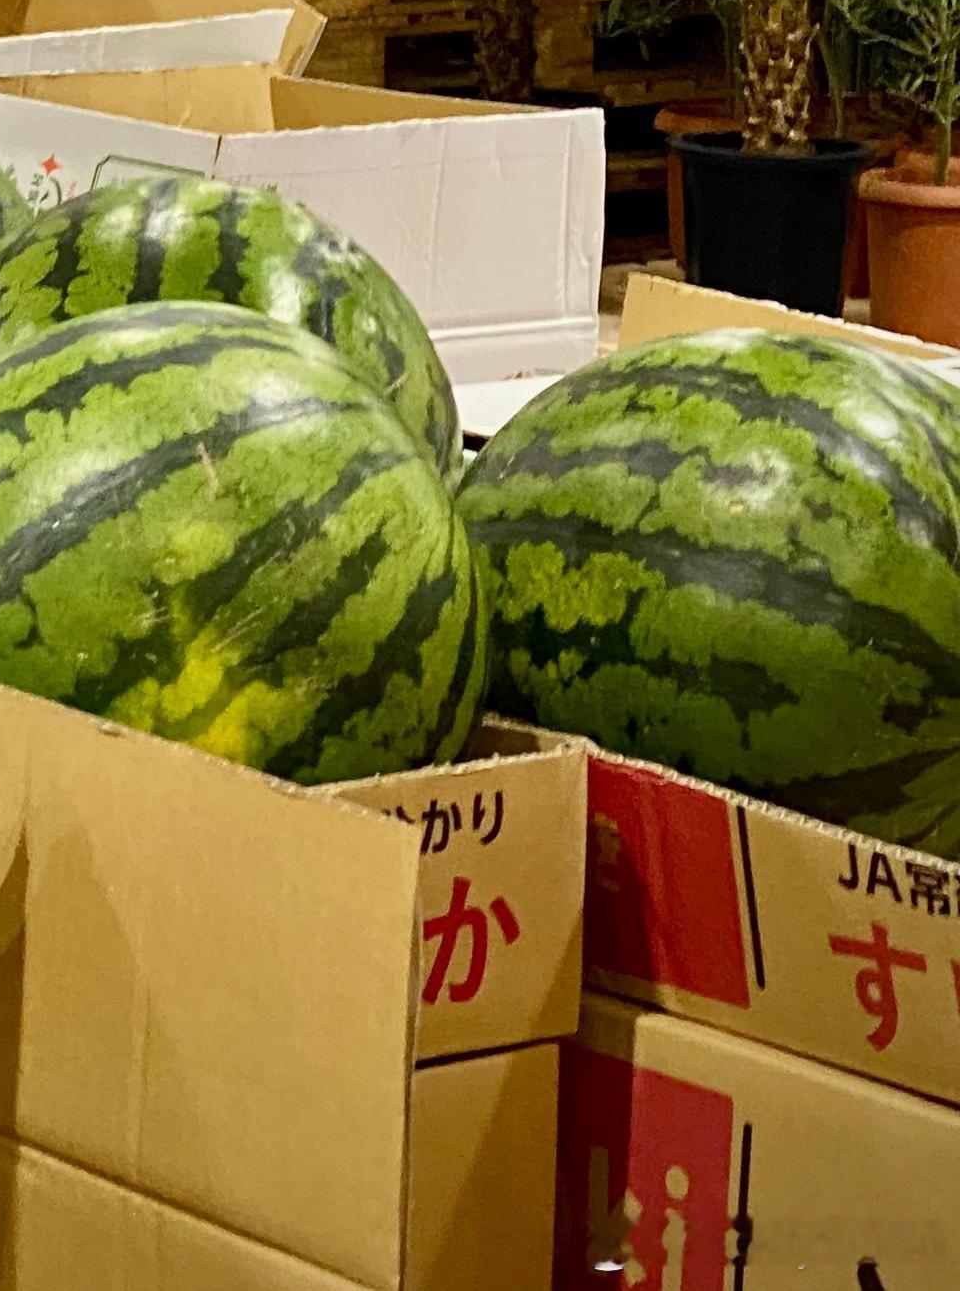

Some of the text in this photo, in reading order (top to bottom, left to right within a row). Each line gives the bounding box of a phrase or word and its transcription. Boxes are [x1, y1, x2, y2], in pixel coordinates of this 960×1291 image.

[384, 789, 504, 855] かり
[838, 843, 960, 916] JA常
[422, 876, 522, 1006] か
